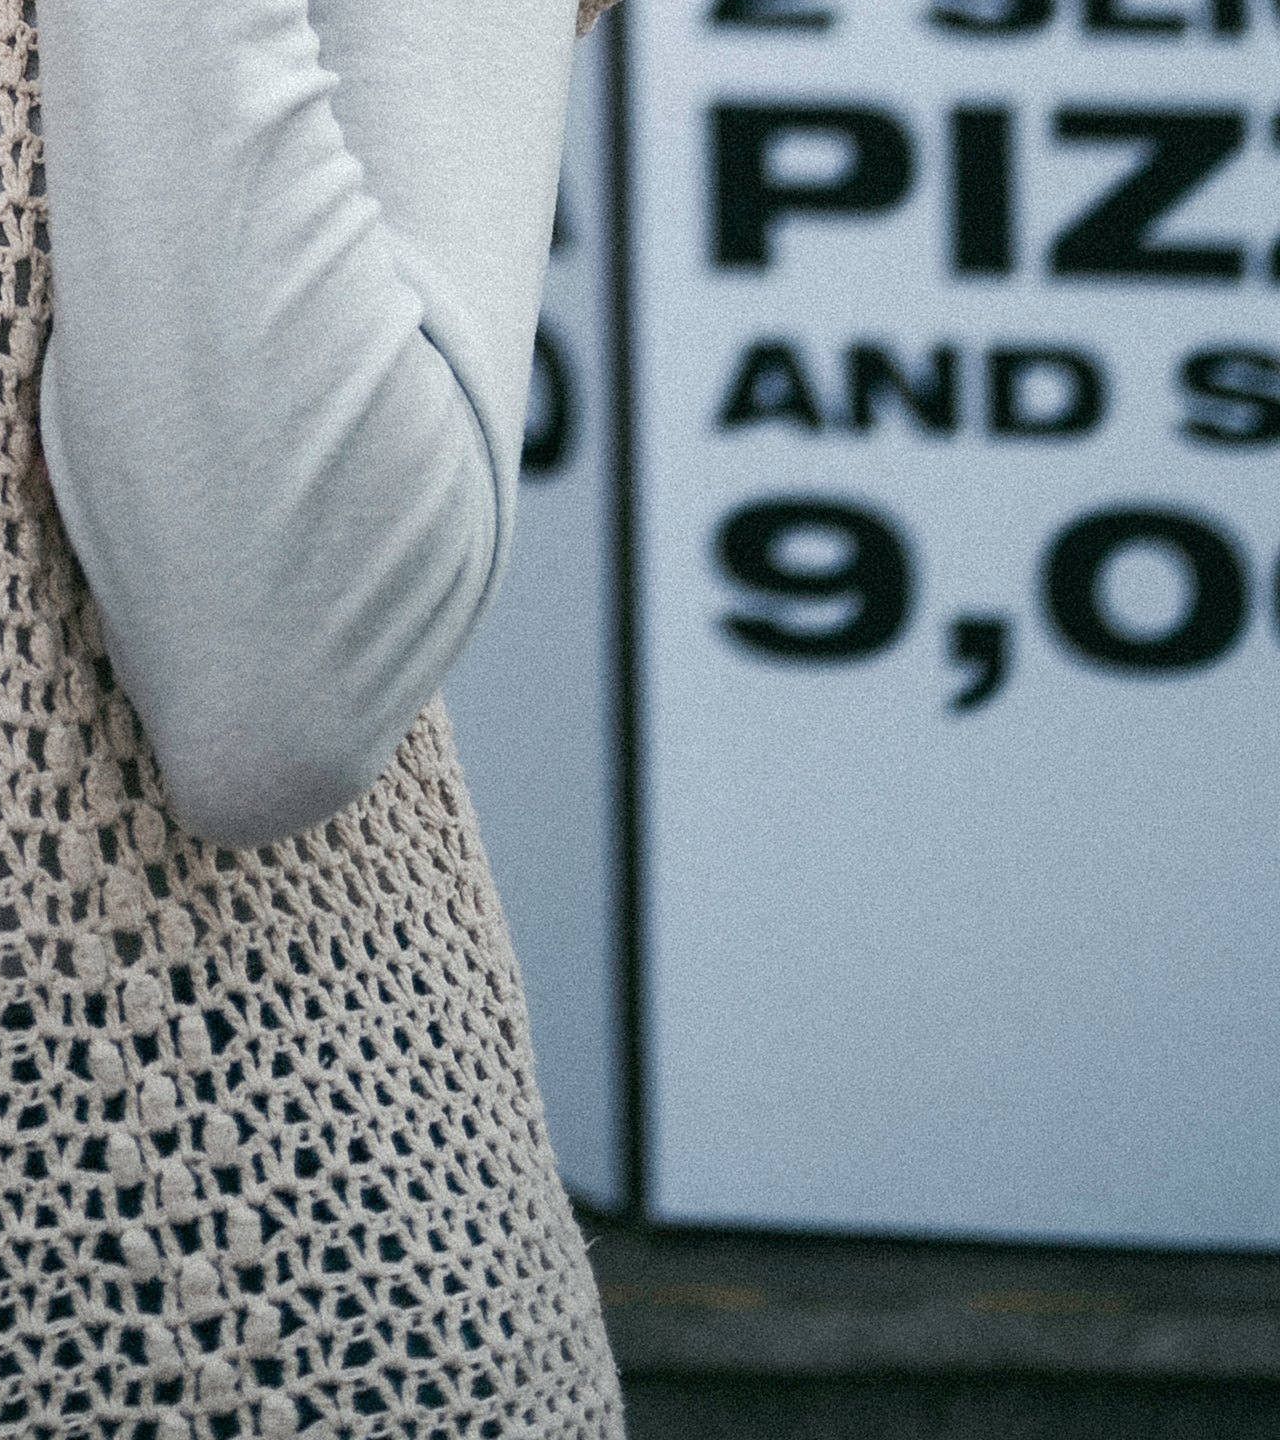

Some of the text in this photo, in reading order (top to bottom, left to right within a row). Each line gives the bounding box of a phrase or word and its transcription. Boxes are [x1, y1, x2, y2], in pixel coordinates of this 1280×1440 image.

[707, 100, 1280, 278] PIZ
[715, 338, 1109, 441] AND
[712, 494, 1280, 713] 9,0
